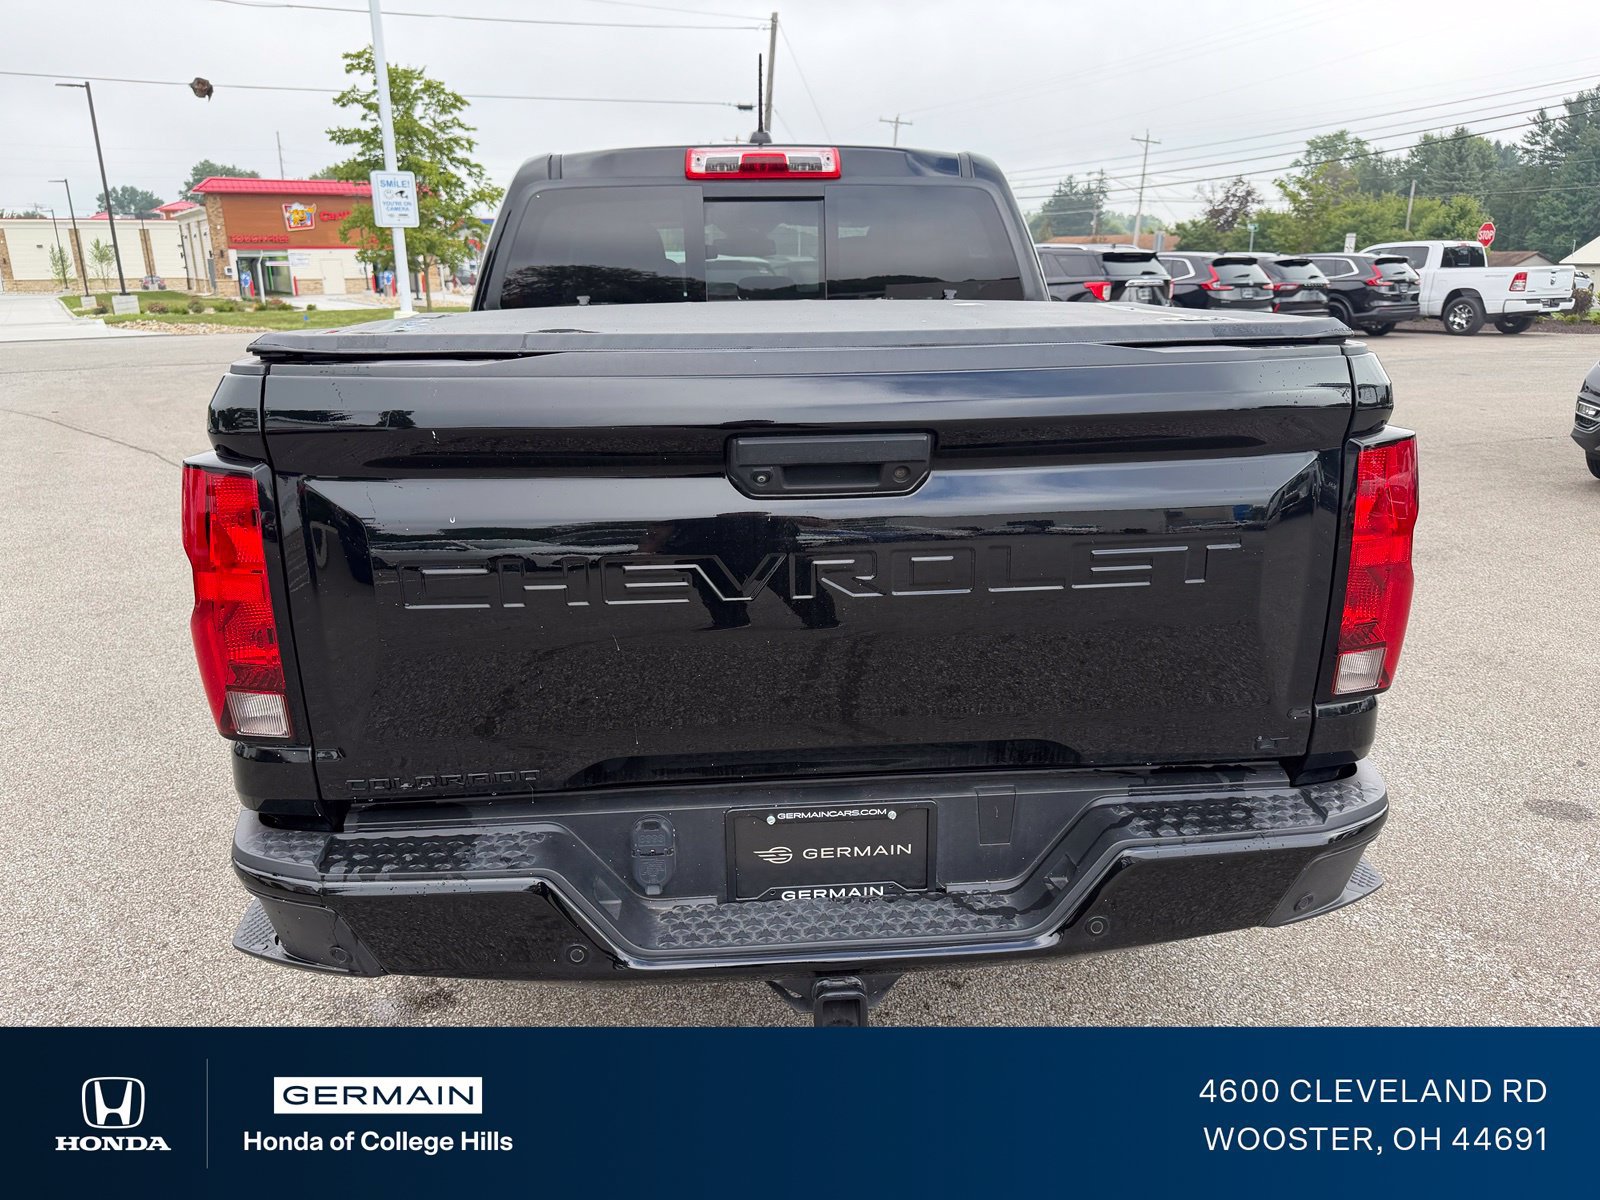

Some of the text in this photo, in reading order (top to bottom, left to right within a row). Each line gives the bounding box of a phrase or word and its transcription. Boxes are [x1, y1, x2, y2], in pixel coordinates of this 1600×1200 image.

[380, 179, 410, 188] SMILE!
[1478, 230, 1494, 240] STOP
[397, 533, 1242, 610] CHEVROLET
[345, 769, 541, 792] COLORADO
[777, 808, 887, 820] GERMAINCARS.COM
[803, 844, 912, 860] GERMAIN
[781, 885, 884, 901] GERMAIN
